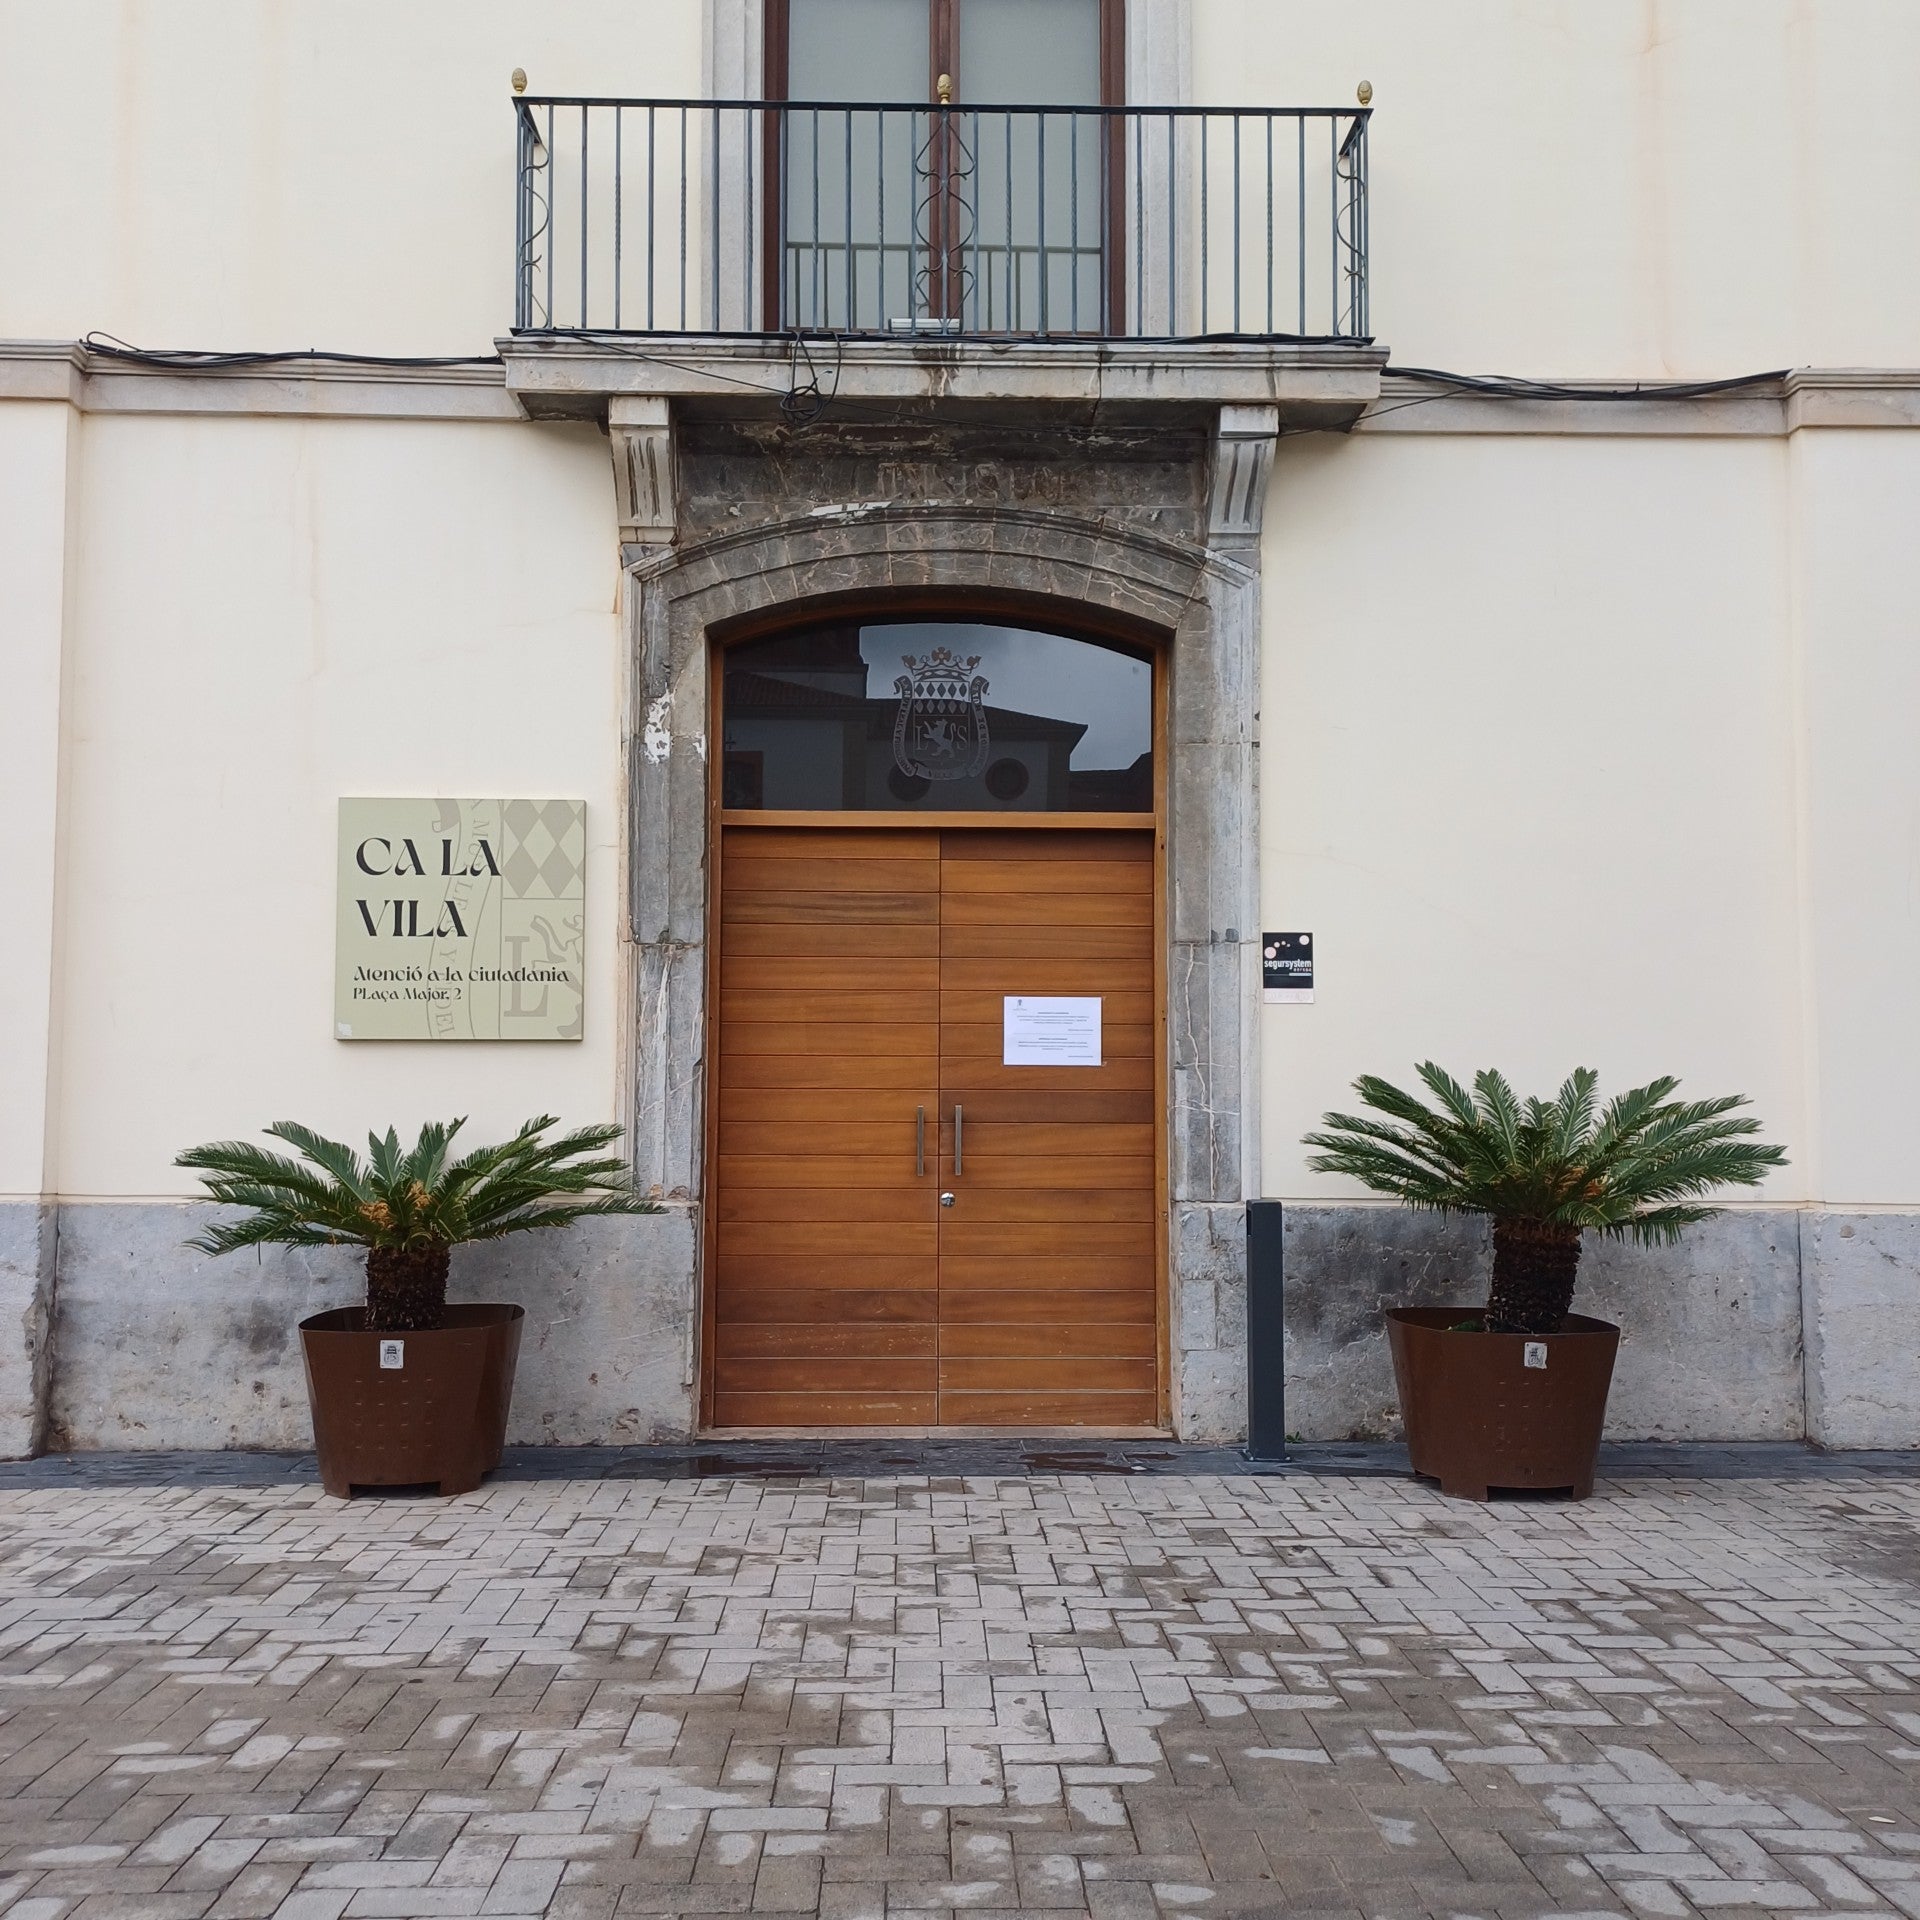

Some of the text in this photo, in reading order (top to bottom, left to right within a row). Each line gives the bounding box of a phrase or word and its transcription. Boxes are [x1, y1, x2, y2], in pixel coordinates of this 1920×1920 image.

[915, 725, 929, 751] L
[956, 725, 968, 750] S
[356, 837, 502, 877] CA LA
[355, 899, 469, 938] VILA
[353, 966, 570, 982] Atenció a la ciutadania
[1264, 959, 1312, 970] segursystem
[453, 988, 462, 1000] 2
